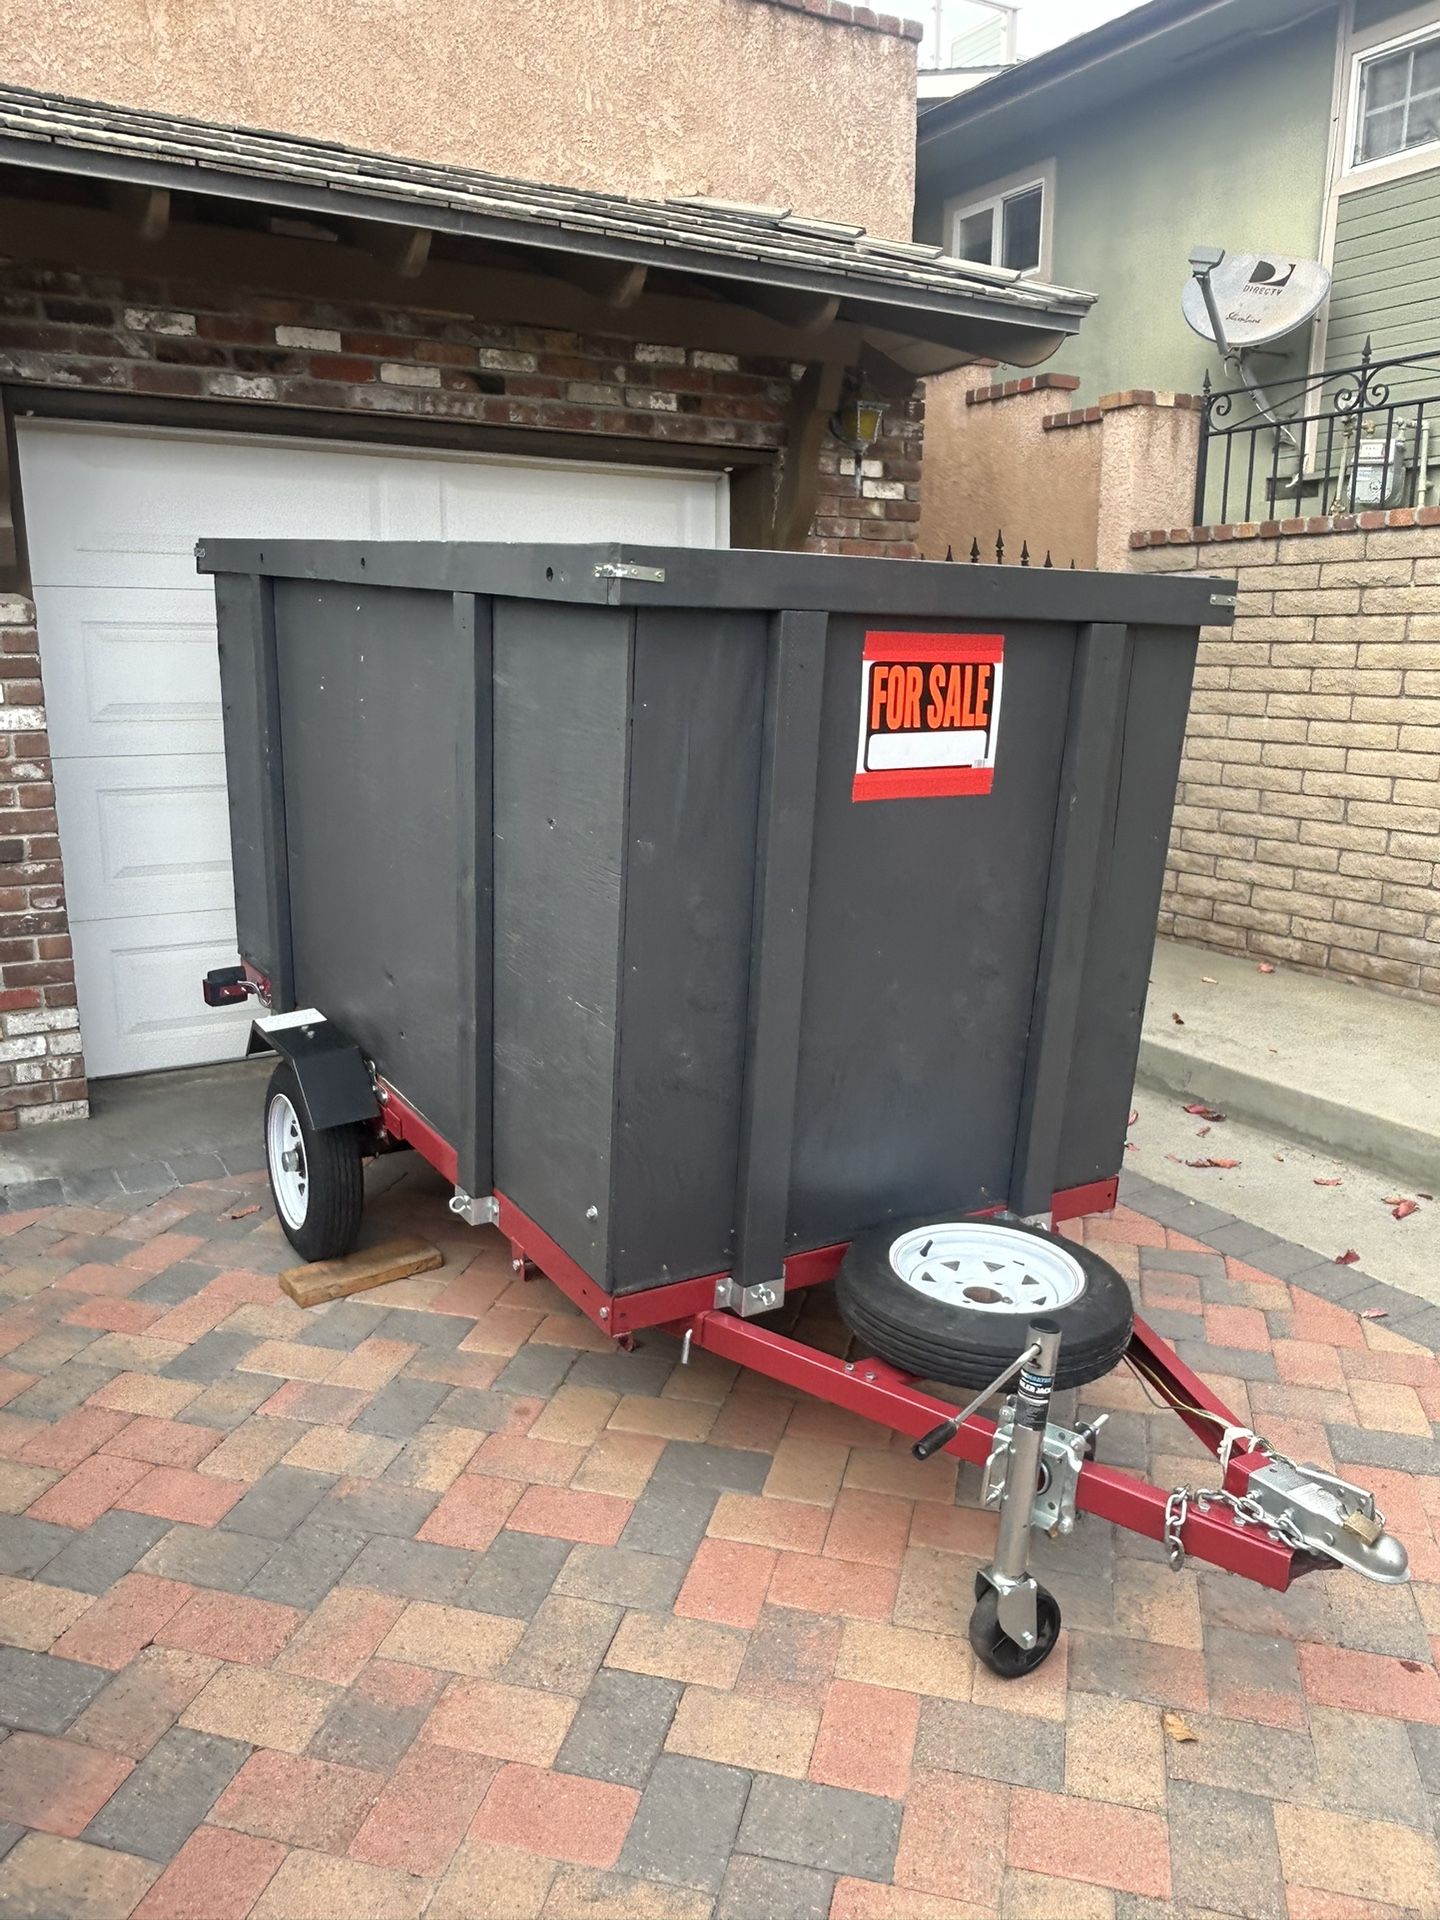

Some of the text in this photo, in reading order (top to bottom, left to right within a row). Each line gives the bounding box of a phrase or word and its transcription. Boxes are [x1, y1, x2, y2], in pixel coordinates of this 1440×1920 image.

[1243, 285, 1283, 296] DIRECTV
[871, 664, 991, 730] FOR SALE
